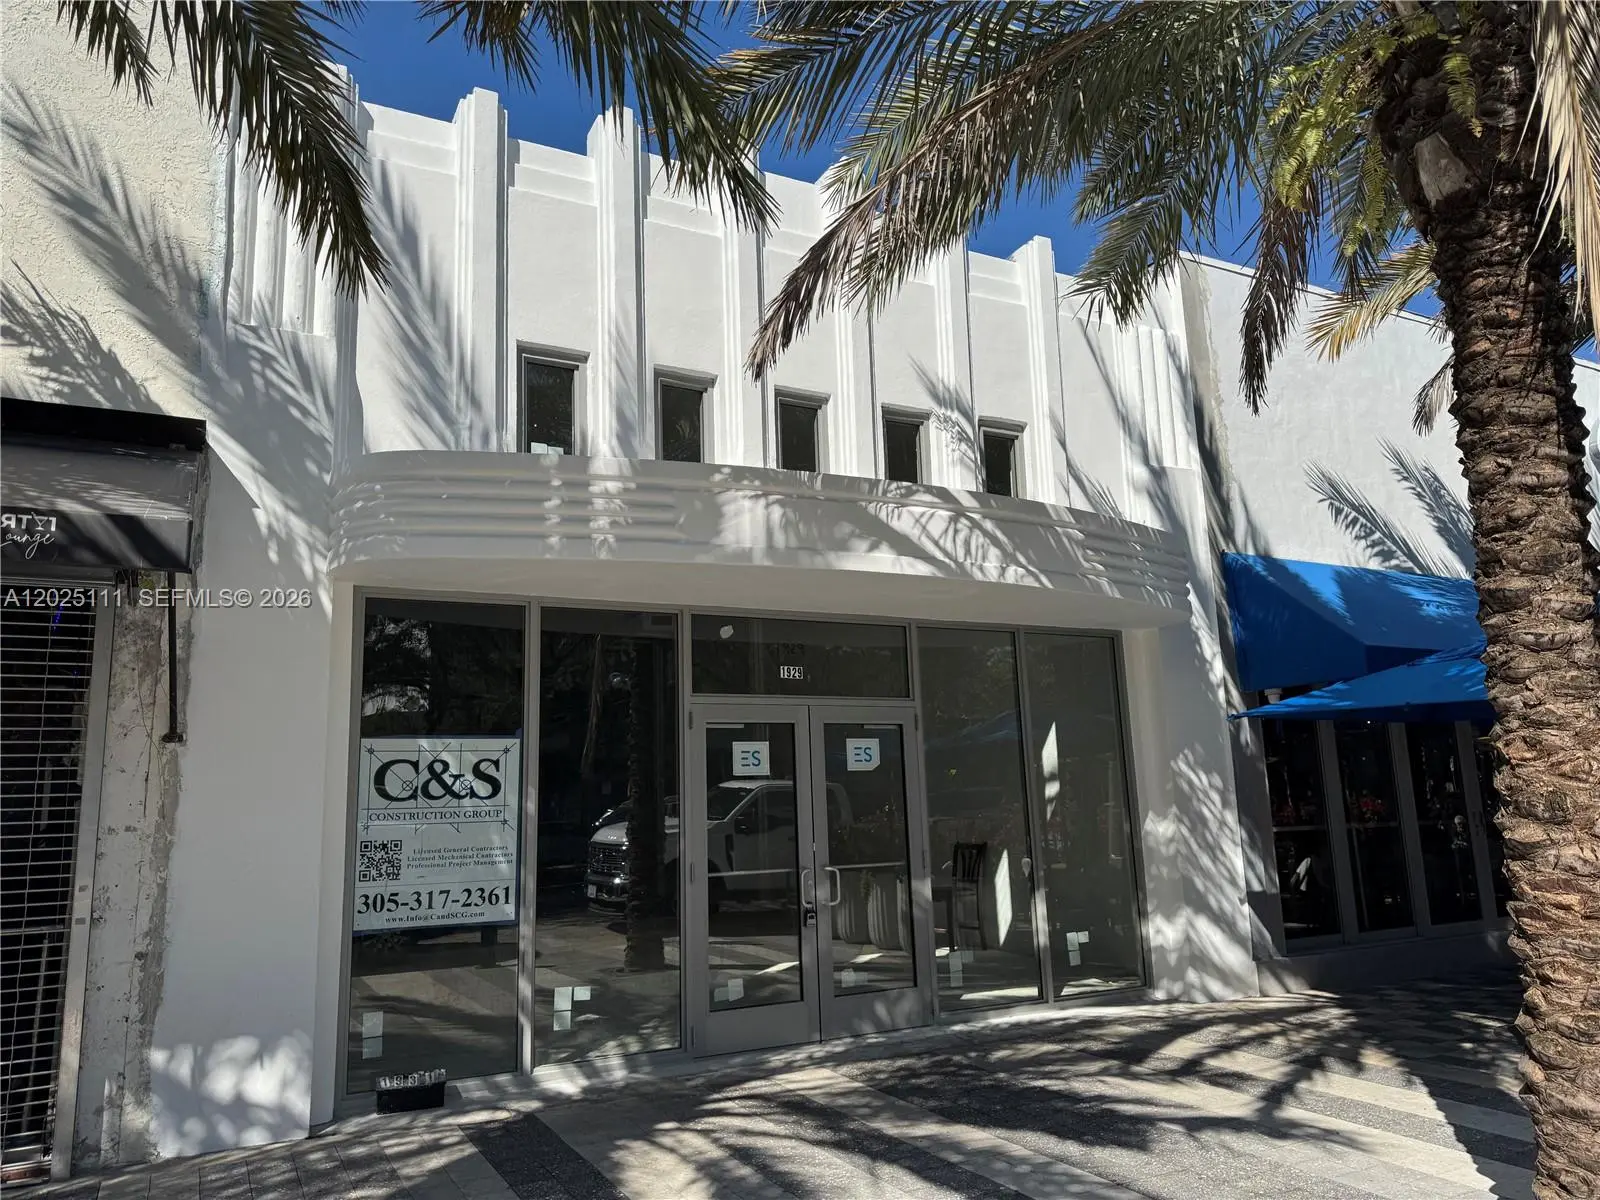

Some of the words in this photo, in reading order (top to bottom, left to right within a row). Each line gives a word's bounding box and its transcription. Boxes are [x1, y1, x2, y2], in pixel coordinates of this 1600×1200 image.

[0, 533, 55, 560] ounge
[780, 666, 803, 679] 1929
[373, 758, 502, 802] C&S
[369, 810, 461, 822] CONSTRUCTION
[463, 809, 503, 819] GROUP
[413, 847, 442, 856] Licensed
[406, 862, 447, 870] Professional
[448, 861, 472, 869] Project
[473, 859, 513, 867] Management
[357, 885, 511, 915] 305-317-2361
[385, 911, 485, 923] www.Info@CandSCG.com
